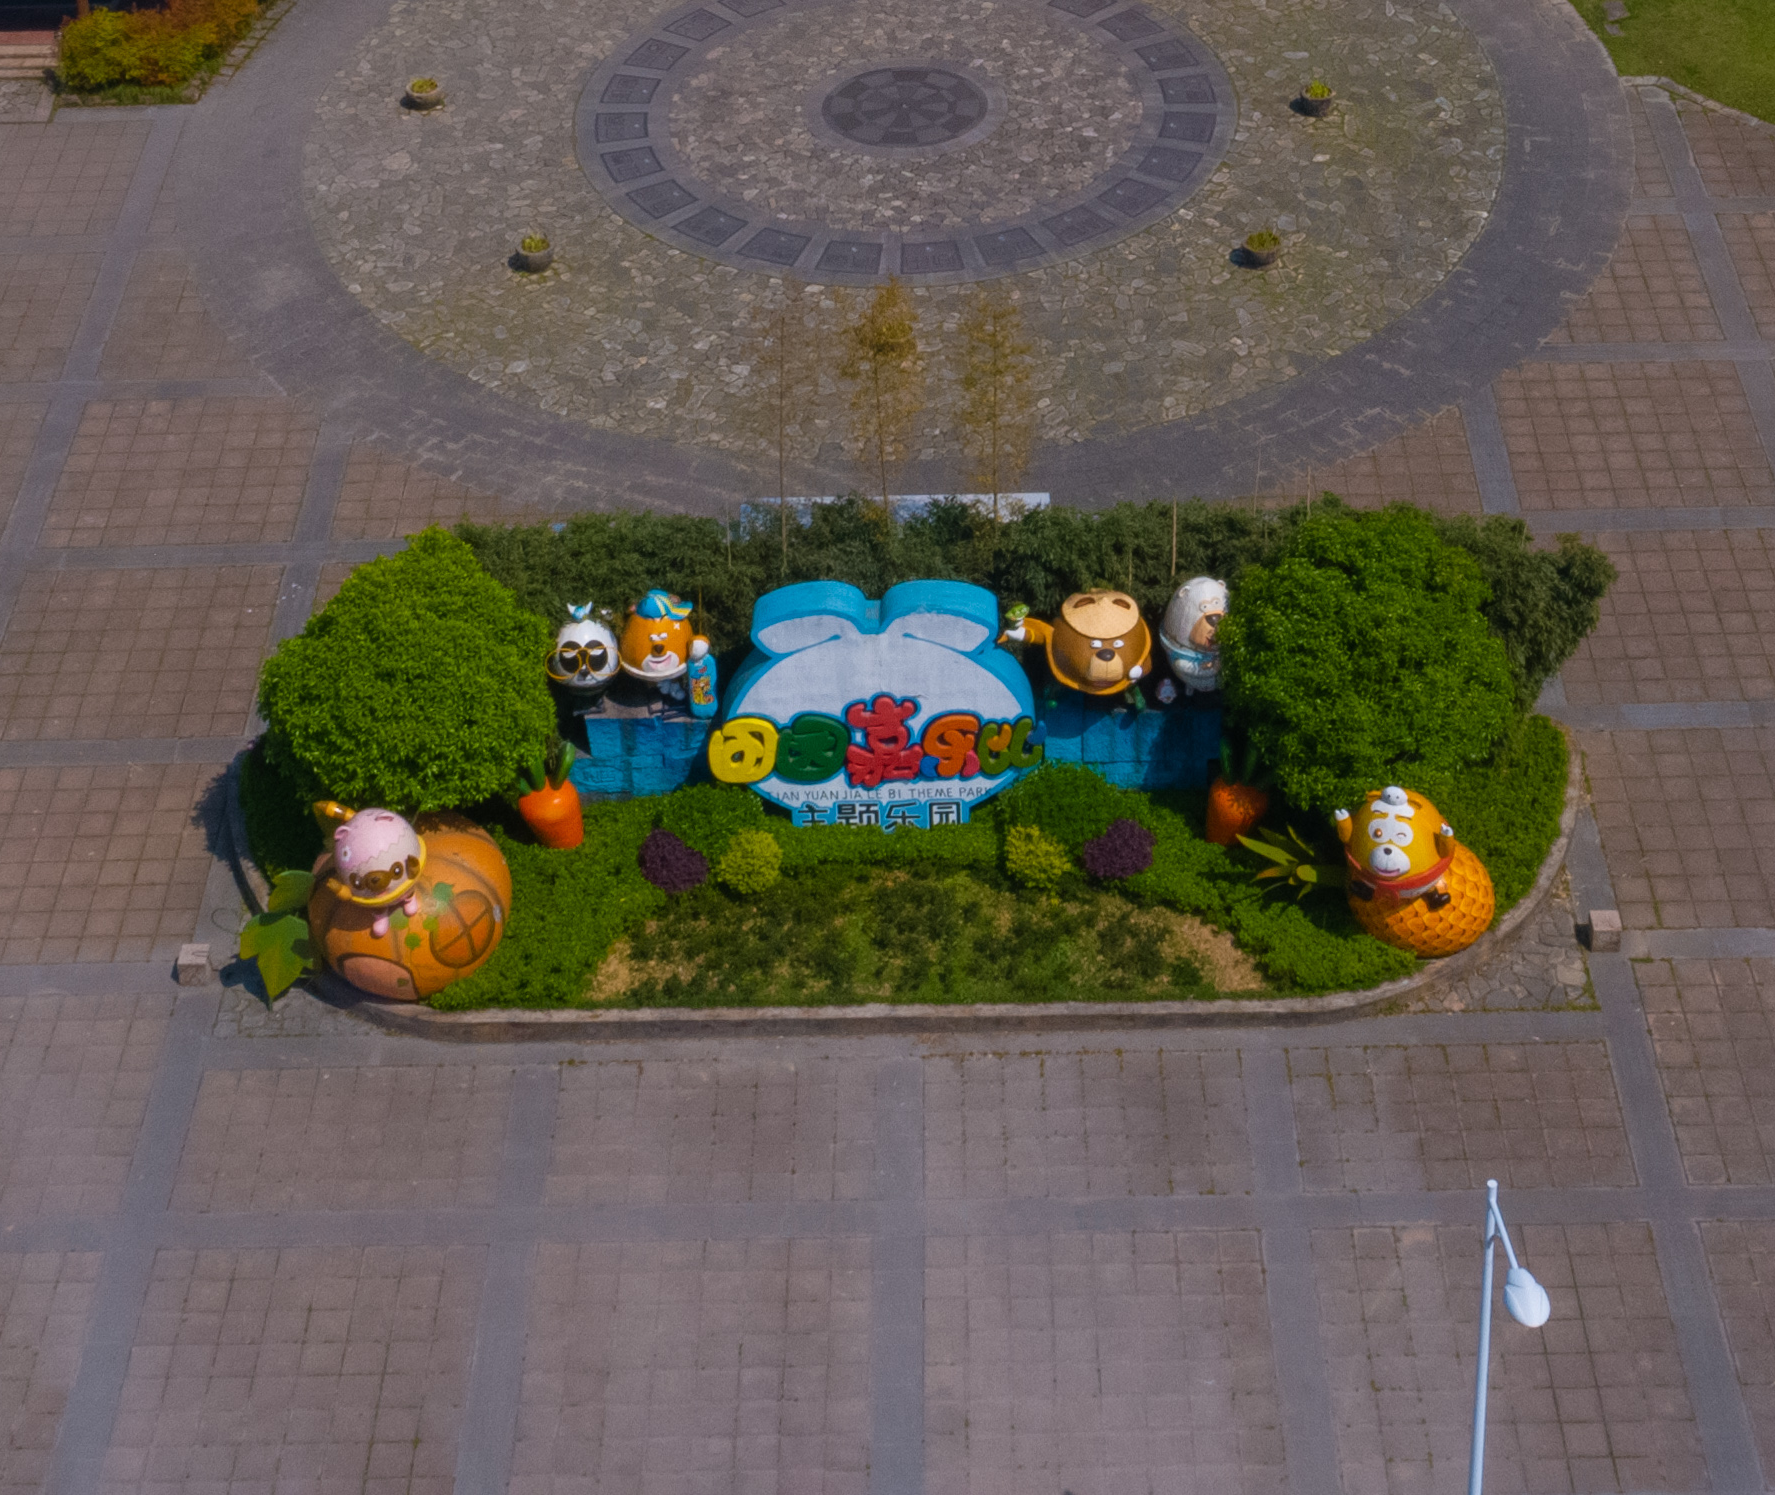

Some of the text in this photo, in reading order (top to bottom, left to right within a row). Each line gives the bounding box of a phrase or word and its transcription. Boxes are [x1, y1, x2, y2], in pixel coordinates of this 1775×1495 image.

[707, 695, 1048, 788] 田园嘉乐比
[804, 790, 839, 801] YUAN
[842, 789, 863, 800] JIA
[888, 788, 901, 799] BI
[908, 788, 954, 798] THEME
[797, 801, 961, 830] 主题乐园
